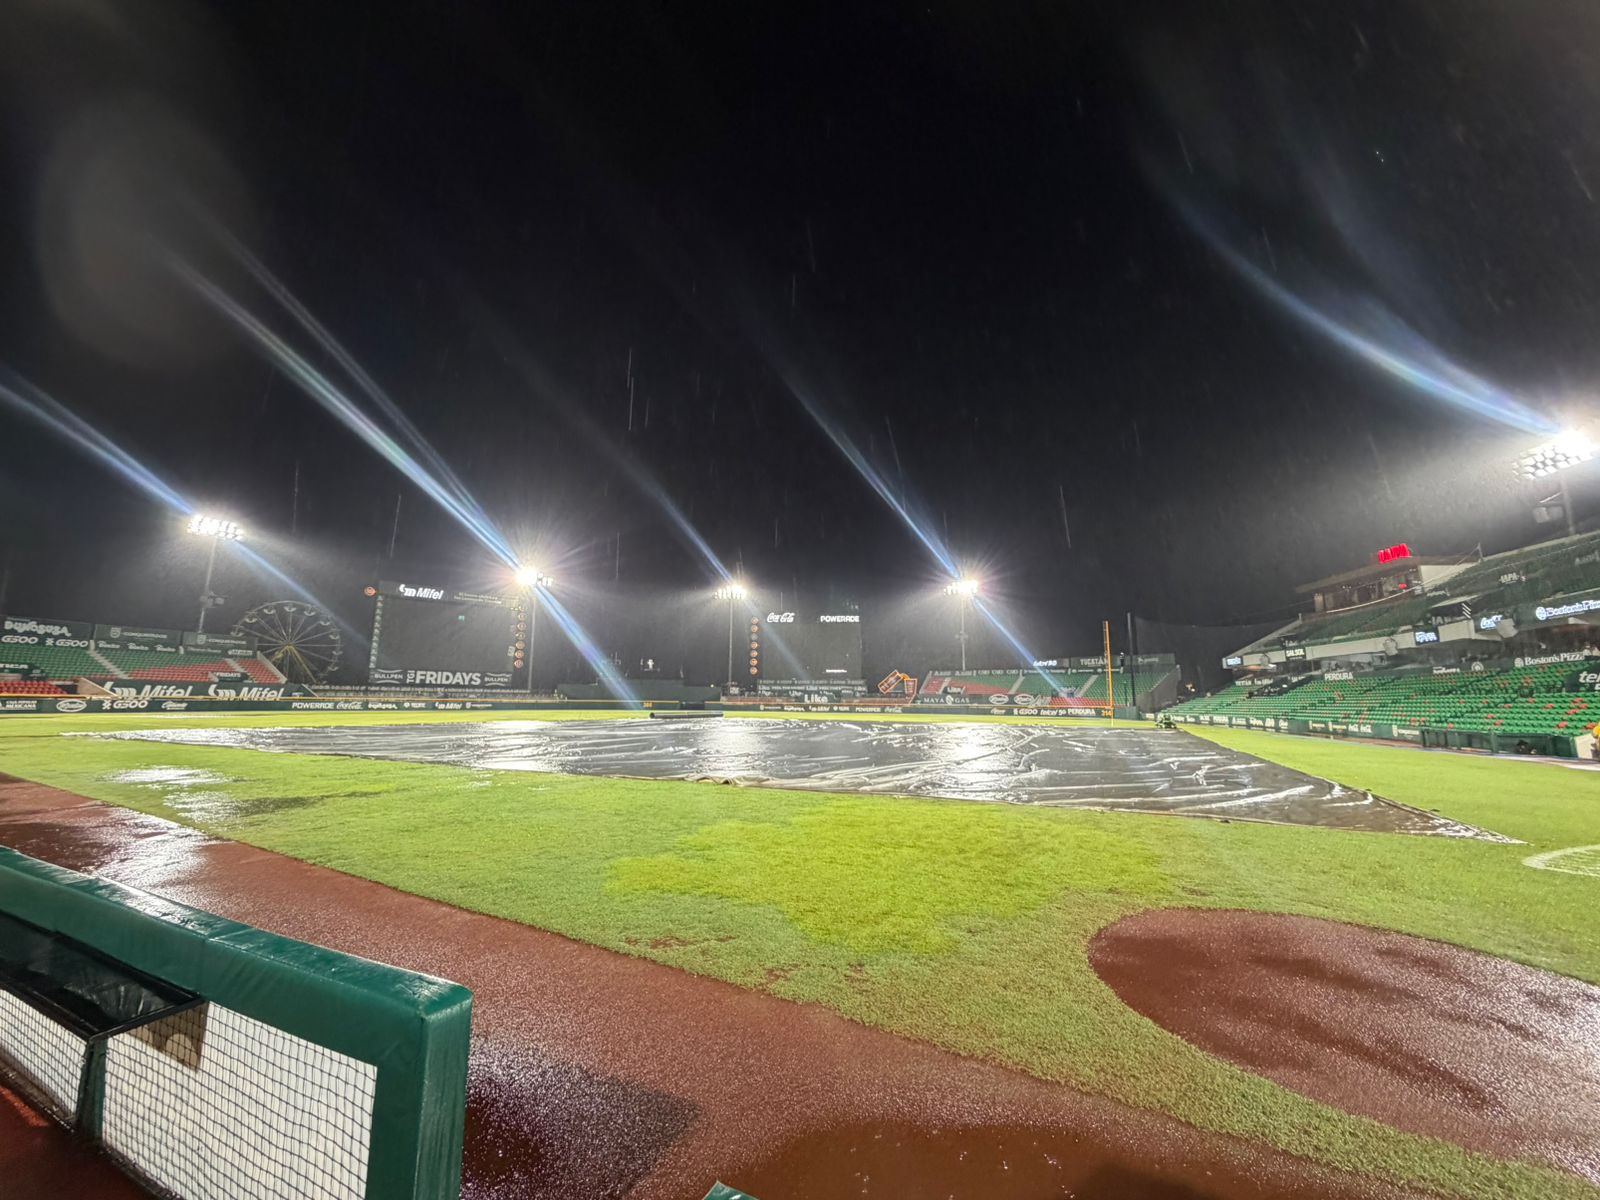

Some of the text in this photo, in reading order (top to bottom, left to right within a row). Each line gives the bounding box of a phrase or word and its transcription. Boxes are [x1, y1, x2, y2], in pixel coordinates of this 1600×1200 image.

[416, 587, 444, 600] Mifel
[56, 639, 88, 647] G500
[1524, 655, 1560, 665] Boston's
[415, 671, 481, 685] FRIDAYS
[1325, 672, 1353, 680] PERDURA
[139, 685, 193, 699] Mifel
[239, 687, 284, 699] Mifel
[804, 694, 828, 703] Like
[113, 701, 148, 709] G500
